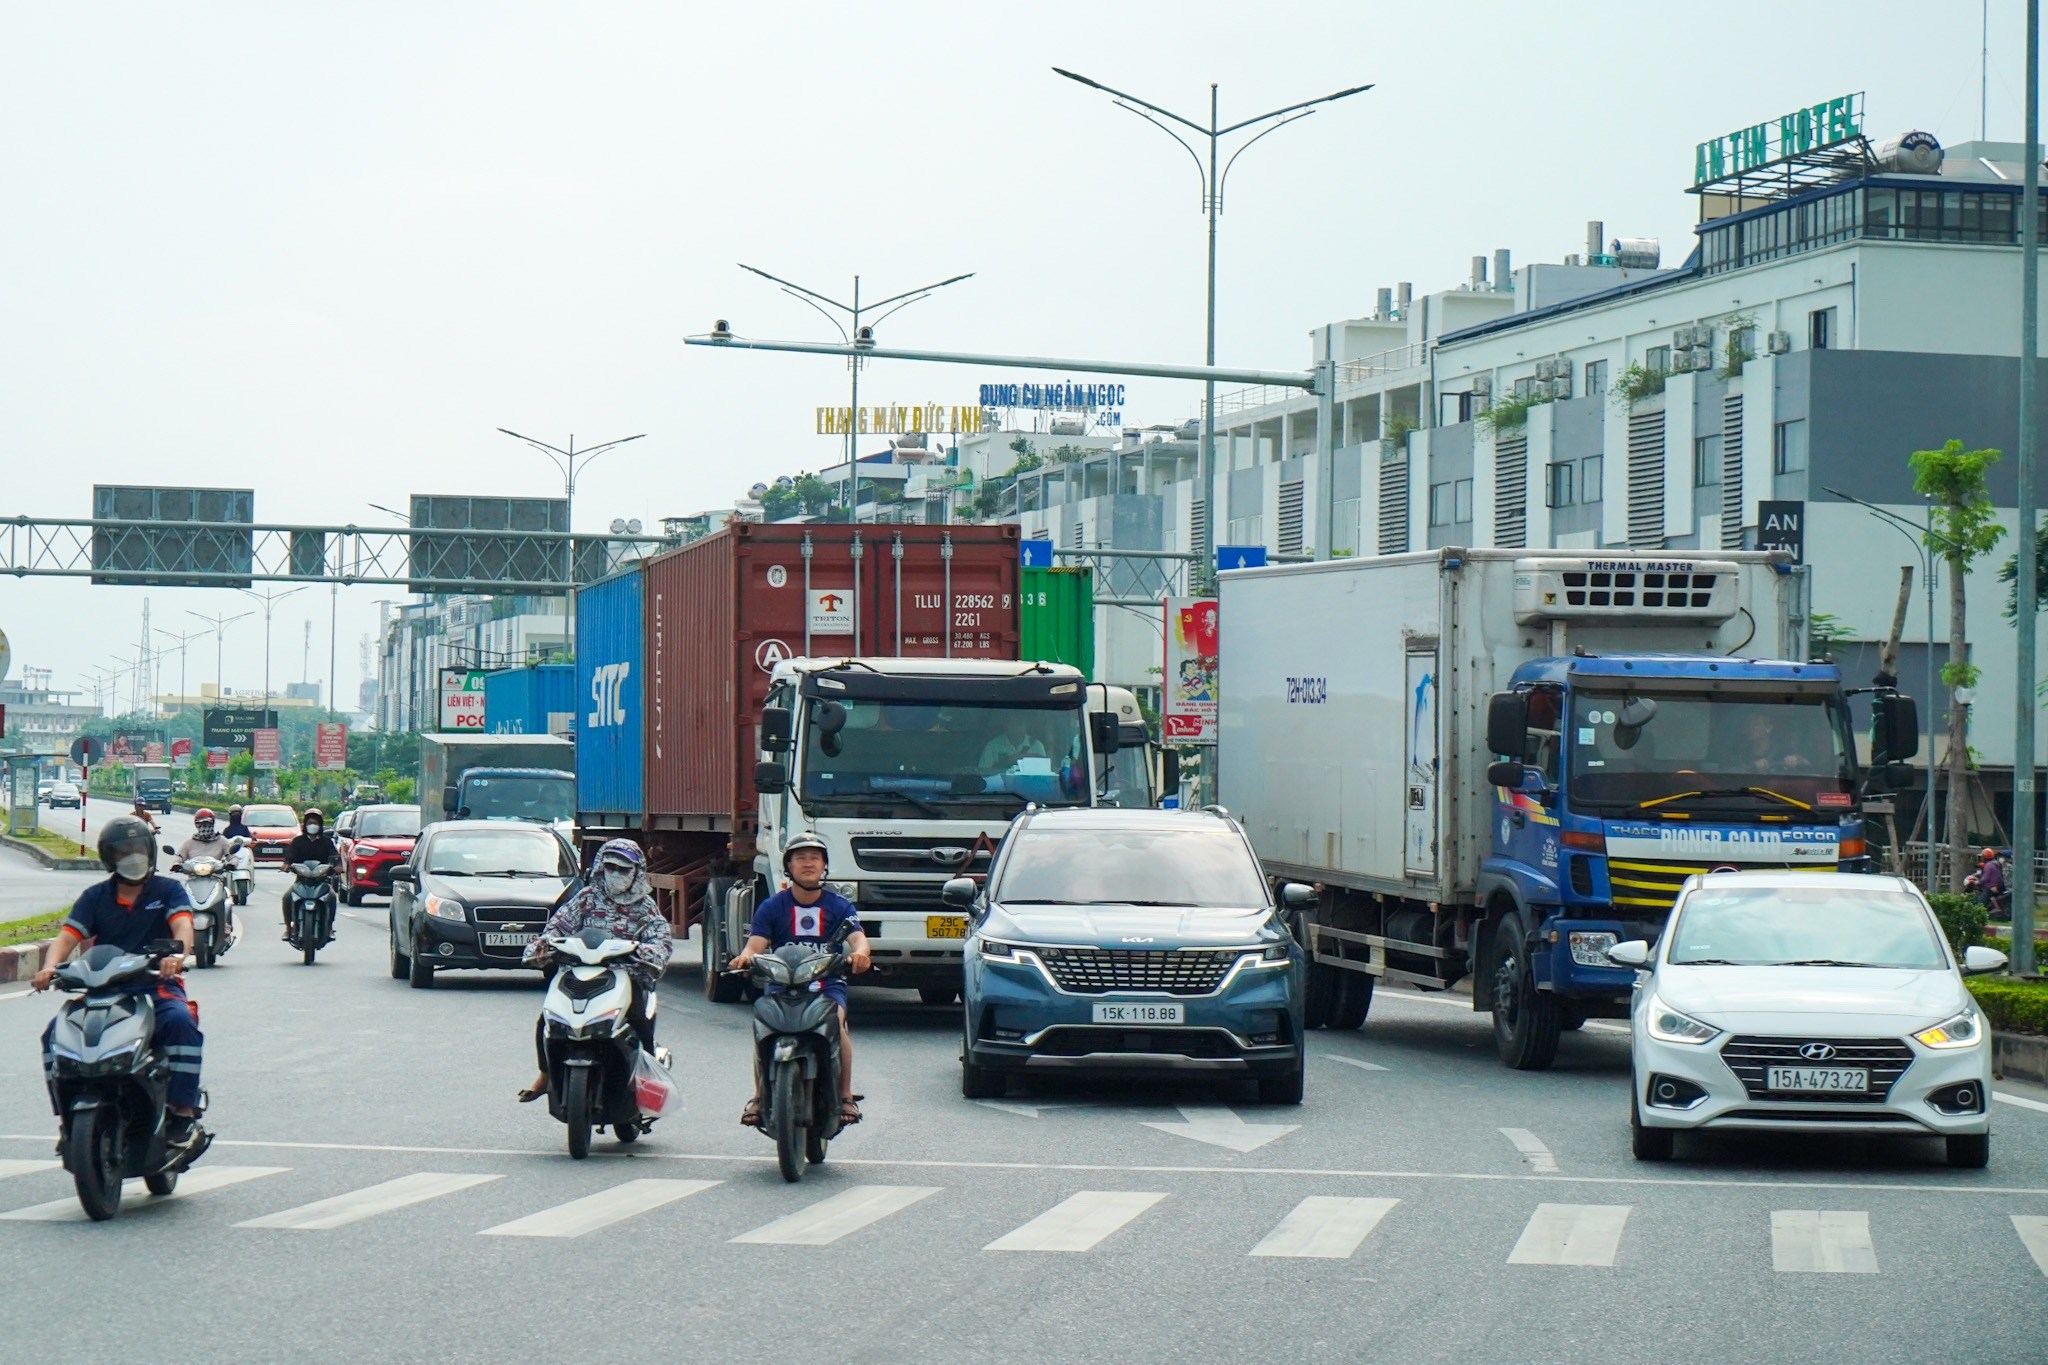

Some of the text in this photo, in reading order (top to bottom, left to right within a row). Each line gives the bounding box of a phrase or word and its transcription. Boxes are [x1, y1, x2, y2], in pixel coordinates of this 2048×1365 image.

[1780, 93, 1860, 160] HOTEL
[816, 407, 867, 433] THANG
[873, 401, 908, 433] MÁY
[912, 401, 945, 433] ĐỨC
[950, 406, 983, 433] ANH
[1765, 513, 1798, 531] AN
[1588, 562, 1693, 571] THERMAL MASTER
[915, 594, 1011, 609] TLLU 228562 9
[955, 613, 981, 627] 22G1
[923, 636, 939, 644] GROSS
[954, 640, 973, 648] 67.200
[762, 643, 784, 668] A
[1611, 826, 1660, 836] THACO
[1661, 828, 1721, 854] PIONER
[1729, 830, 1782, 856] CO.LTD
[940, 918, 959, 927] 29C
[932, 928, 966, 937] 507.78
[1102, 1007, 1176, 1020] 15K-118.88
[1773, 1069, 1865, 1090] 15A-473.22
